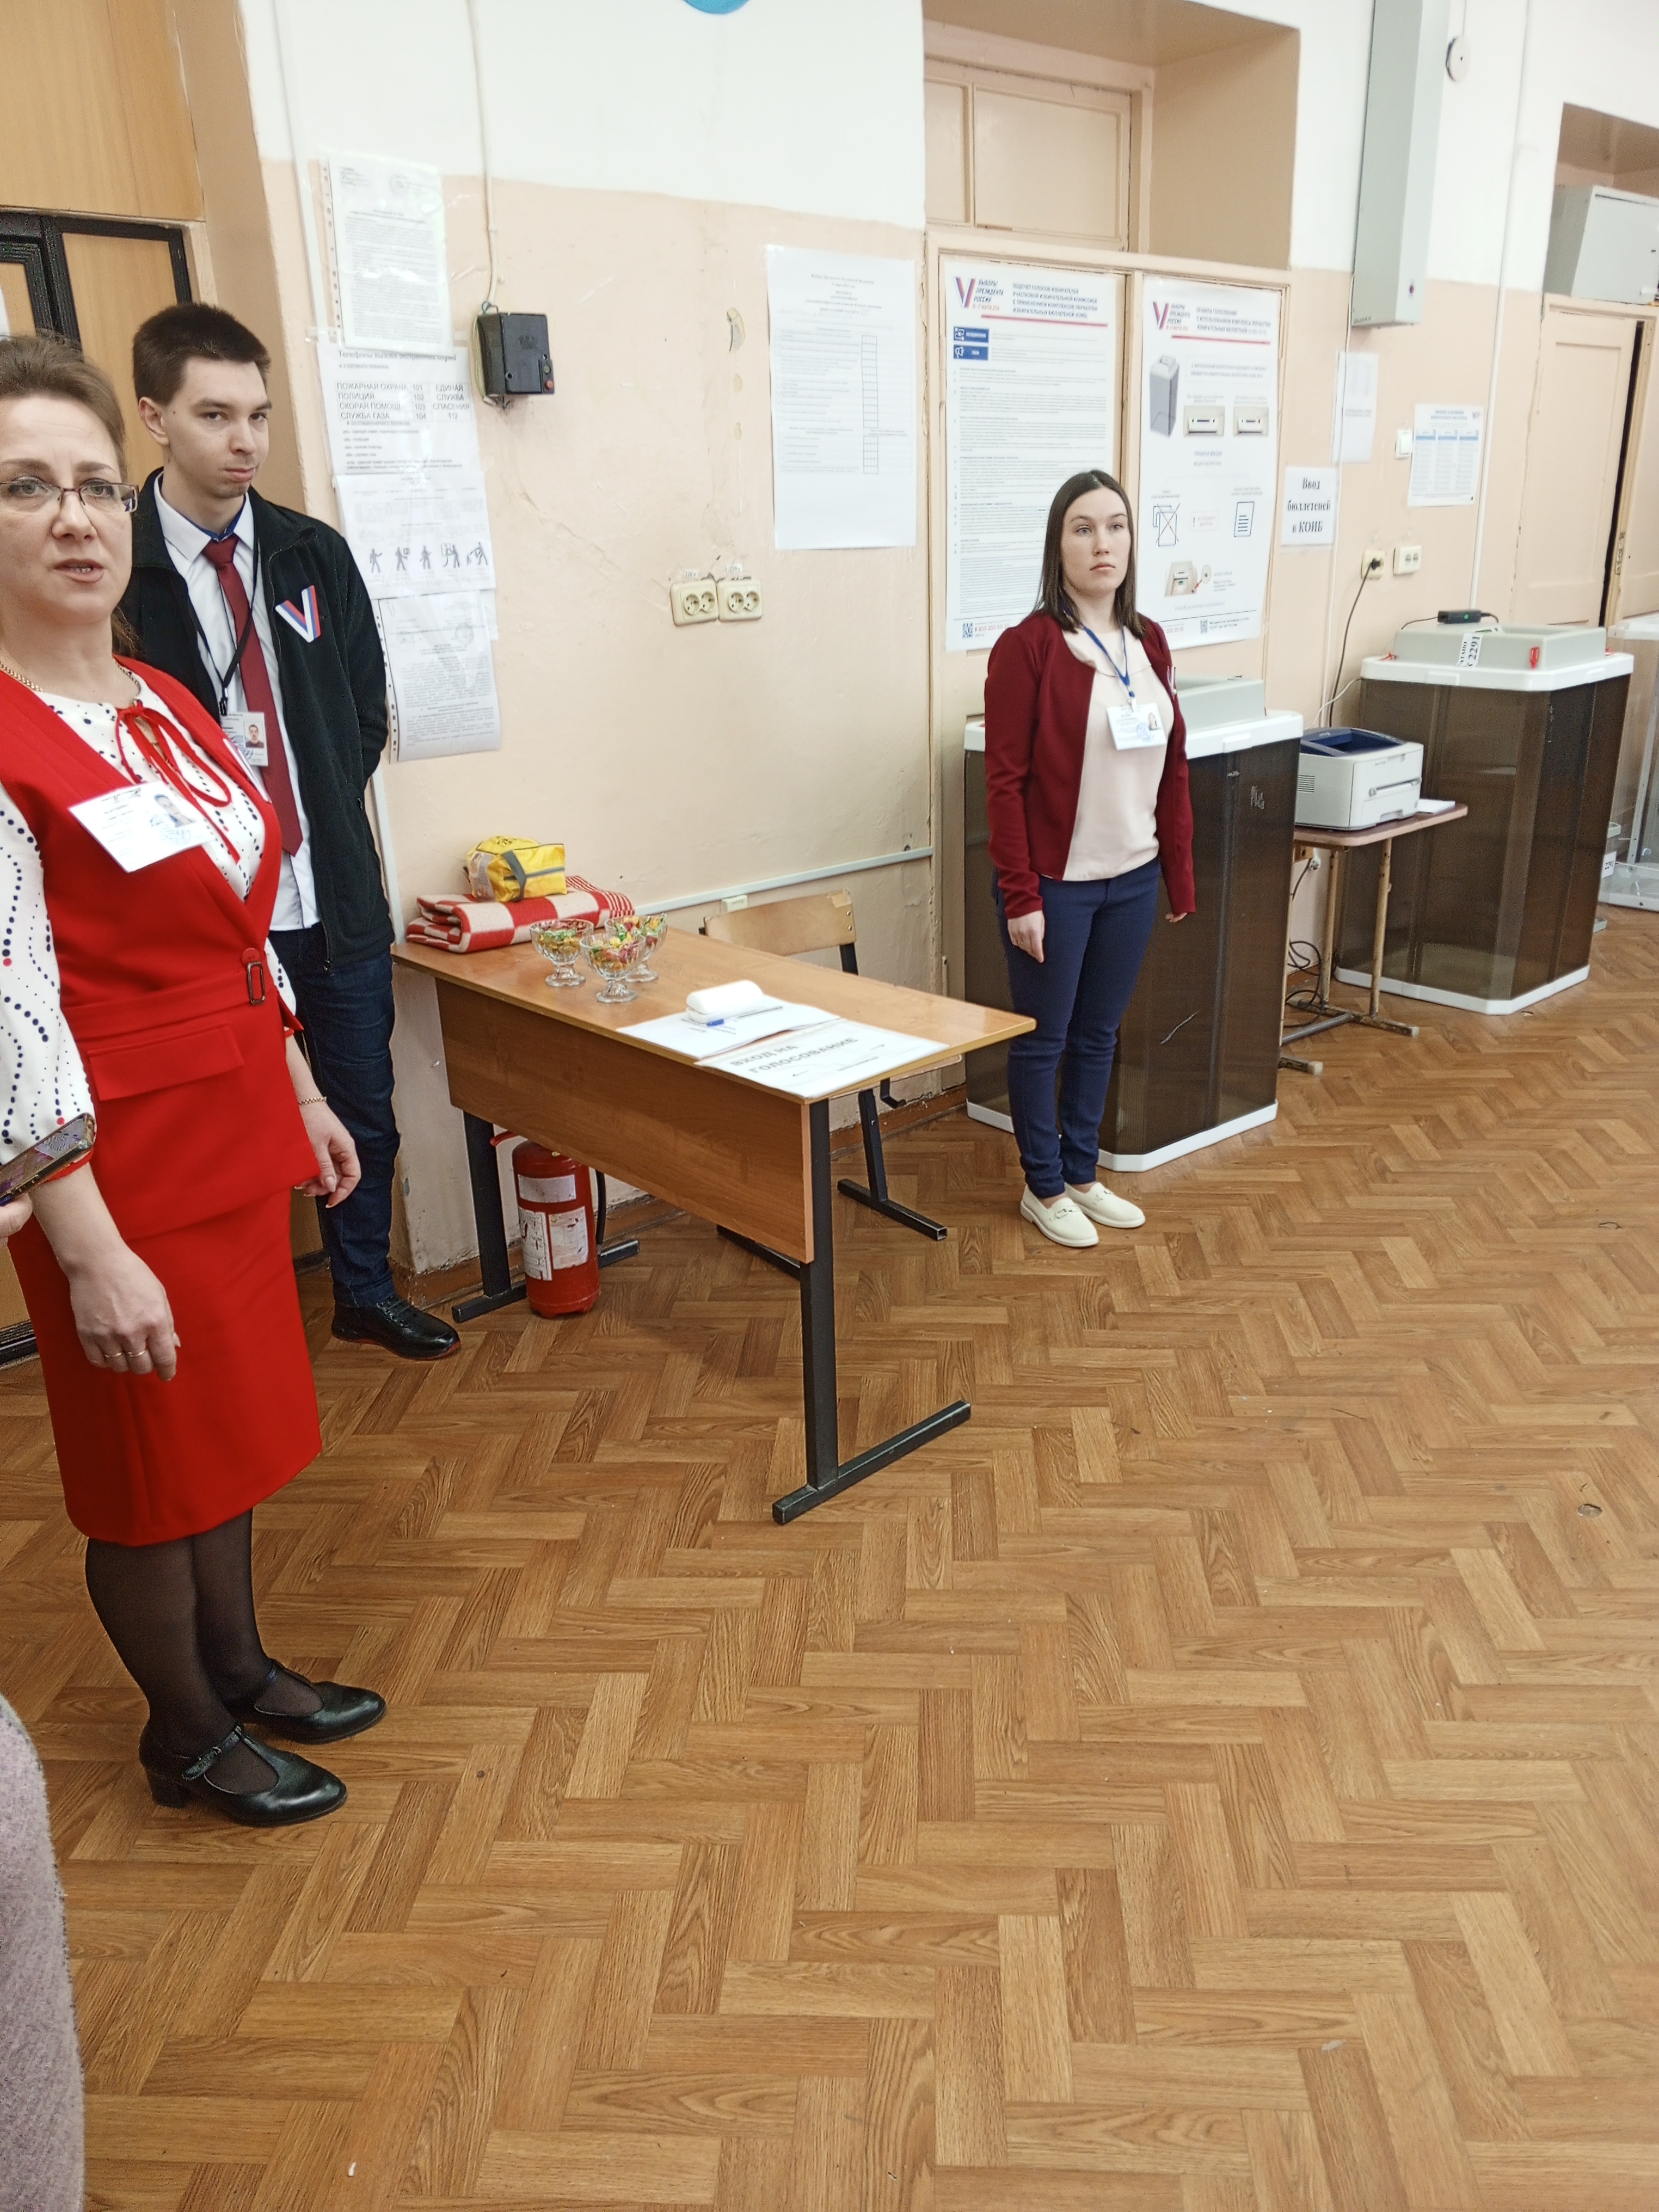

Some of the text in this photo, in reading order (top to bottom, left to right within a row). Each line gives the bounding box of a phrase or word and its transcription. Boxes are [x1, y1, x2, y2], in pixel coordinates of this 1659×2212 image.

[978, 279, 999, 287] ВЫБОРЫ
[975, 287, 1004, 297] ПРЕЗИДЕНТА
[338, 351, 373, 360] Телефоны
[338, 392, 374, 401] ПОЛИЦИЯ
[1302, 477, 1320, 490] Ввод
[1287, 500, 1330, 511] бюллетеней
[1292, 520, 1323, 533] в КОИБ
[1468, 636, 1480, 660] 2291
[729, 1044, 800, 1067] ВХОД НА
[748, 1037, 859, 1074] ГОЛОСОВАНИЕ
